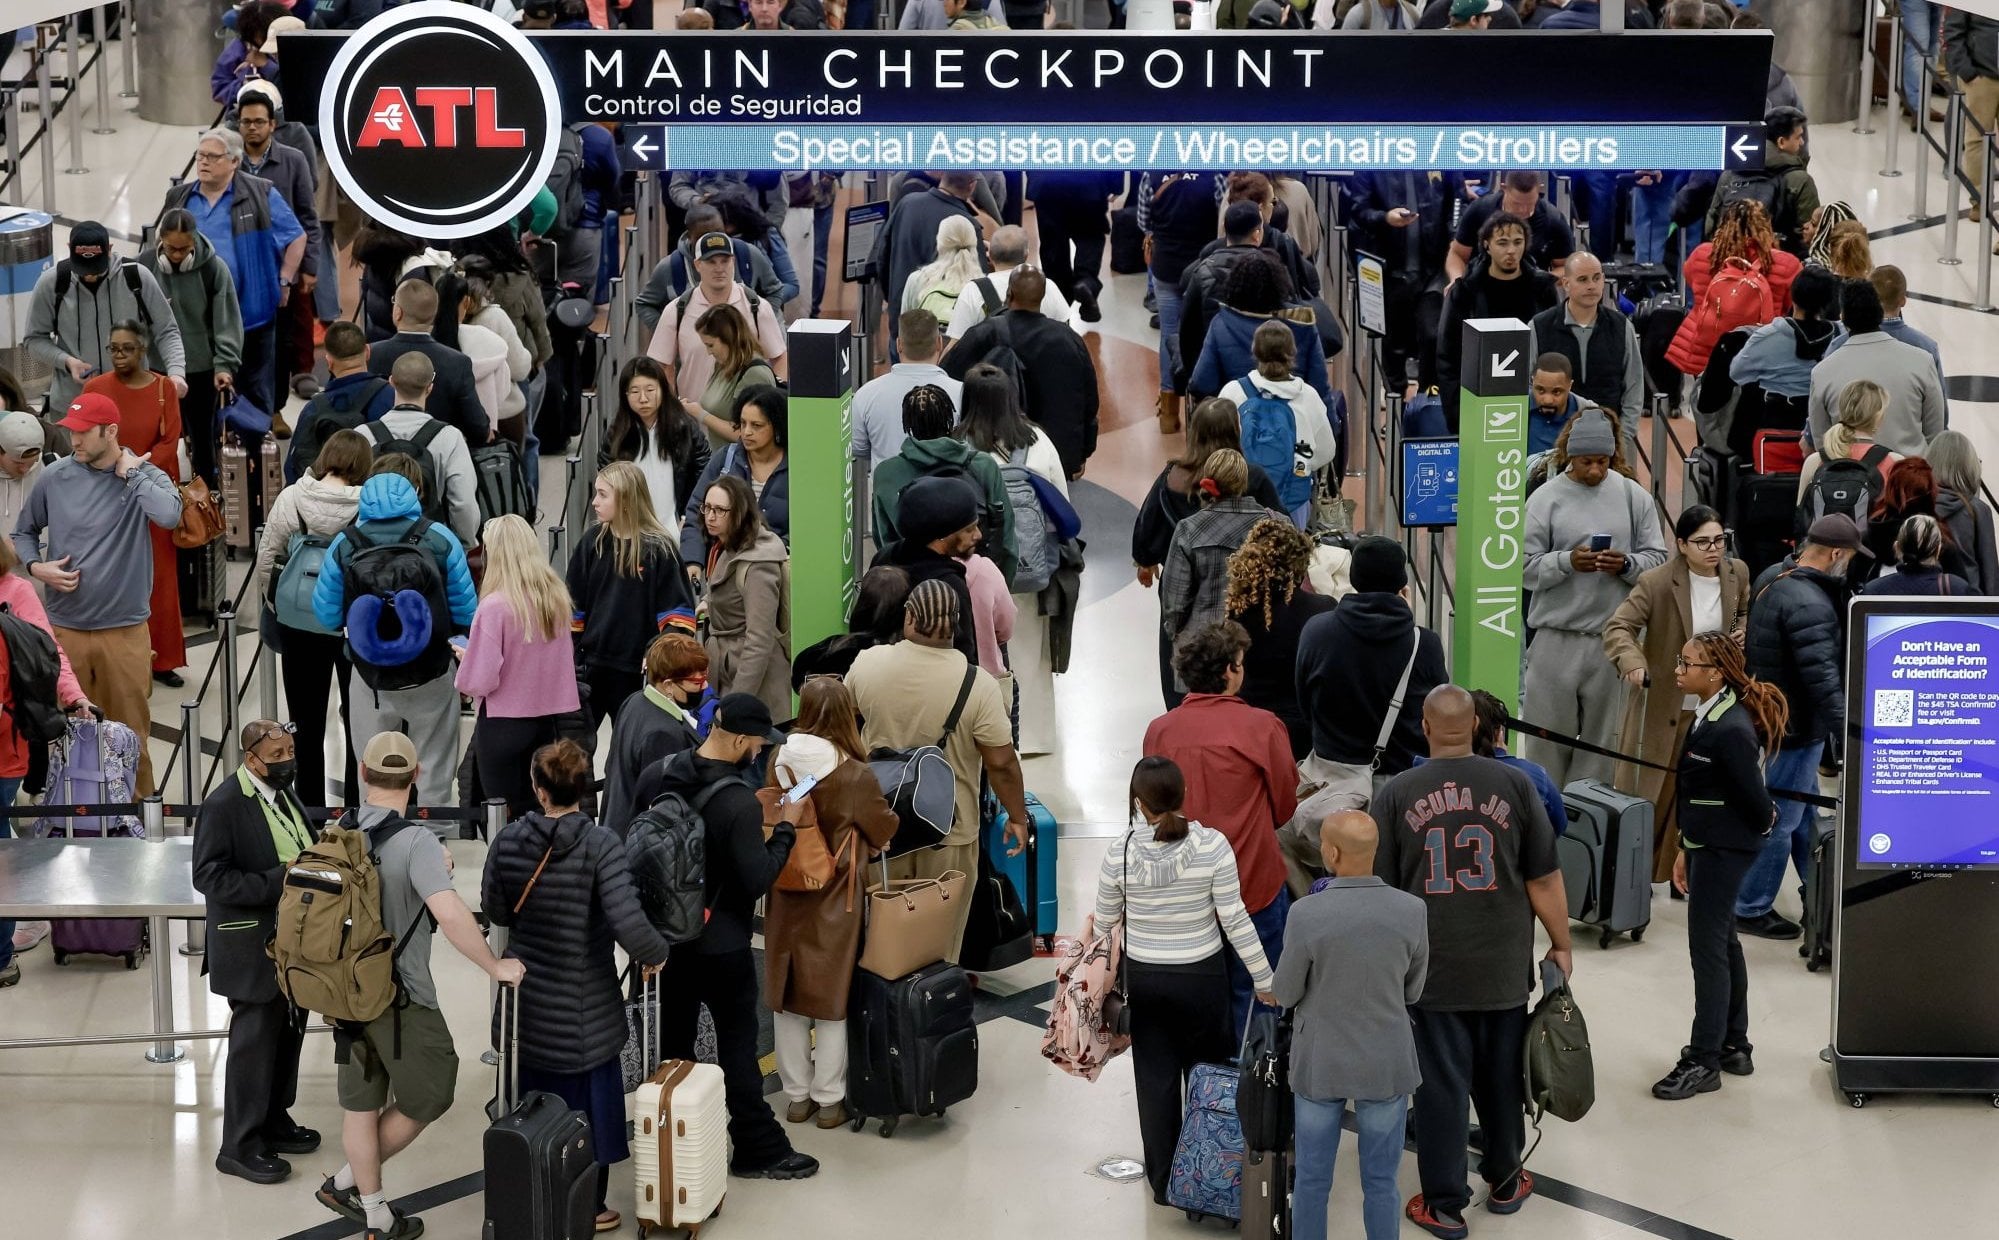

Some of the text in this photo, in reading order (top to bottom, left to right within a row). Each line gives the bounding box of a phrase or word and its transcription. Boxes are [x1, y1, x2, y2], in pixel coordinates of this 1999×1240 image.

[585, 48, 1324, 89] MAIN CHECKPOINT
[357, 86, 526, 149] ATL
[585, 93, 862, 119] Control de Seguridad
[773, 131, 1618, 169] Special Assistance / Wheelchairs / Strollers
[843, 441, 853, 565] Gates
[1477, 448, 1521, 638] All Gates
[1893, 655, 1988, 666] Acceptable Form
[1901, 641, 1981, 652] Don't Have an
[1892, 668, 1988, 680] of Identification?
[1949, 693, 1960, 701] QR
[1961, 701, 1996, 709] ConfirmID
[1405, 781, 1511, 833] ACUÑA JR.
[1424, 824, 1496, 893] 13
